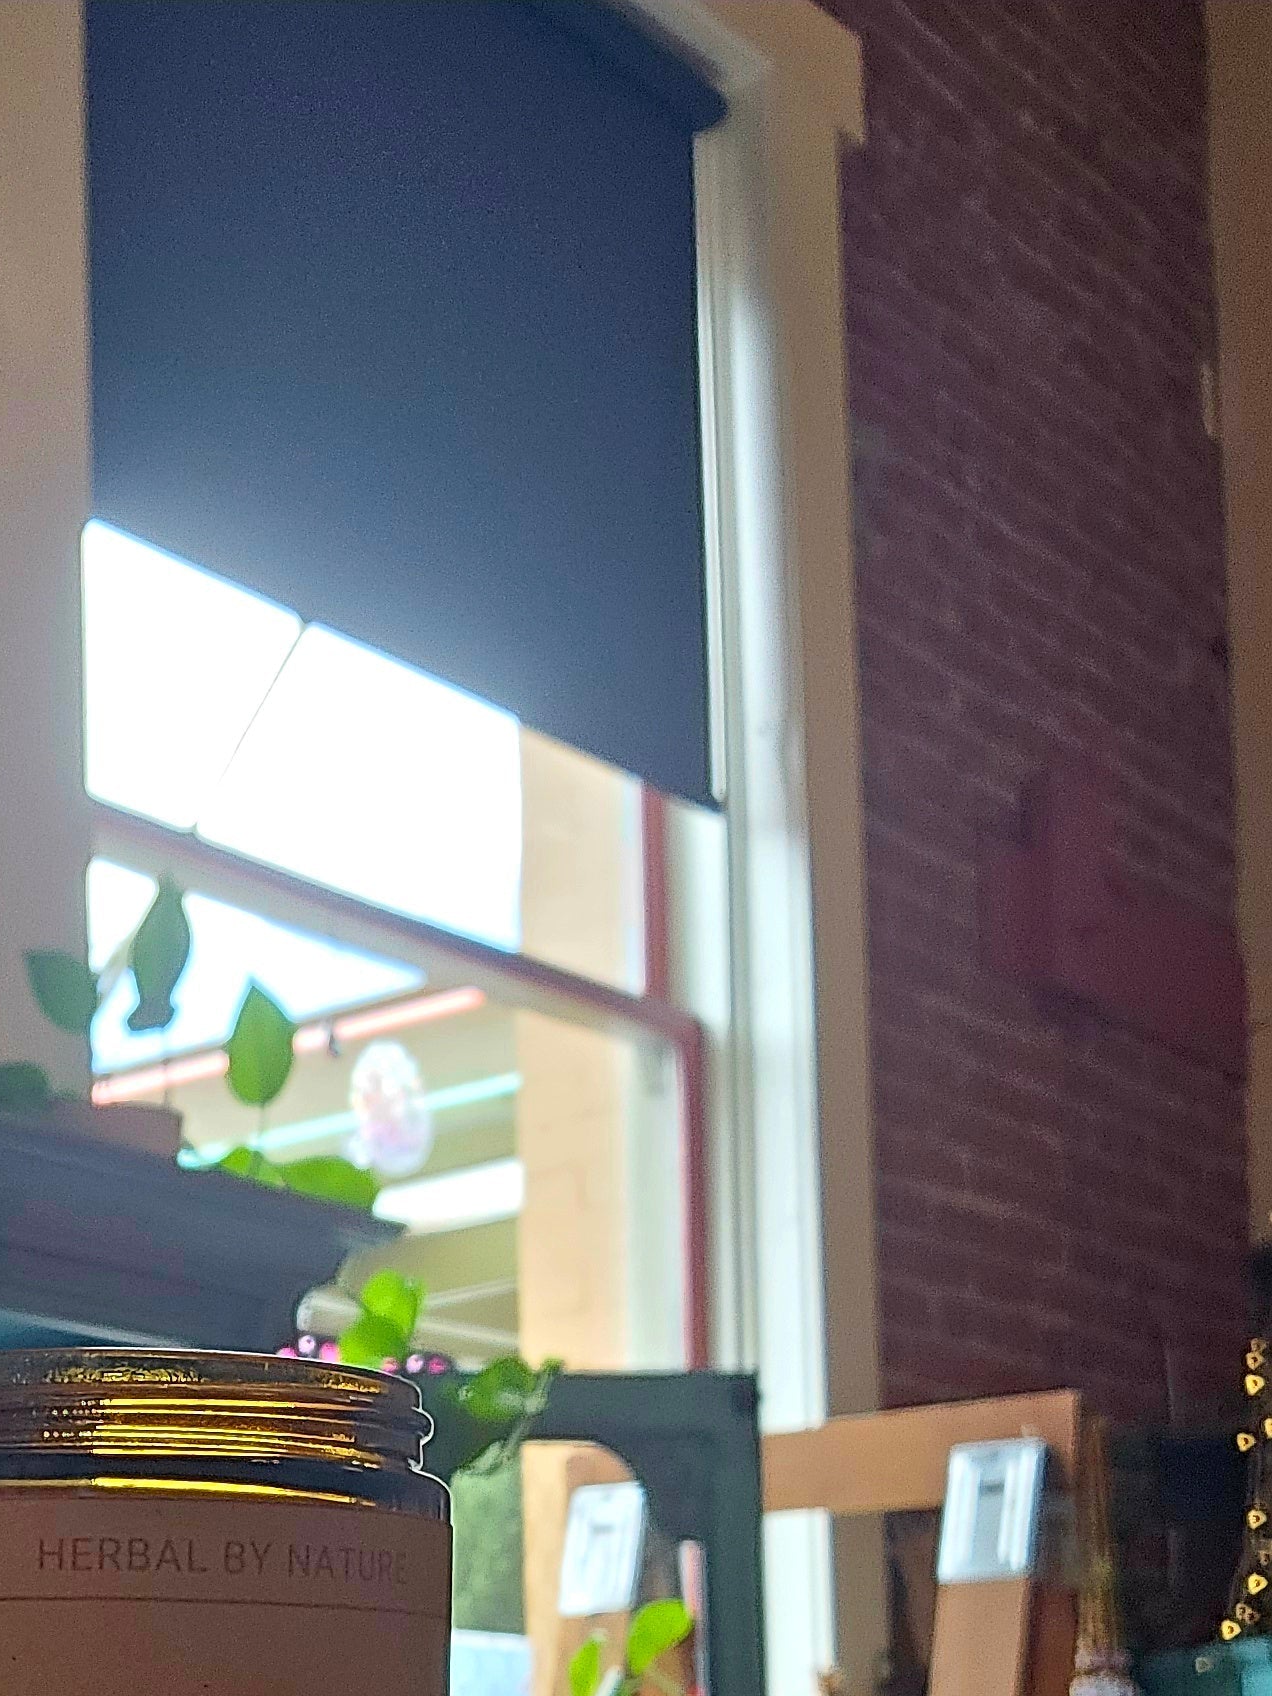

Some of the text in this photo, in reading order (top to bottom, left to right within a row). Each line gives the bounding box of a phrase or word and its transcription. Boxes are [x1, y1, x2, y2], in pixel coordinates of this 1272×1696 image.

[38, 1538, 408, 1585] HERBAL BY NATURE
